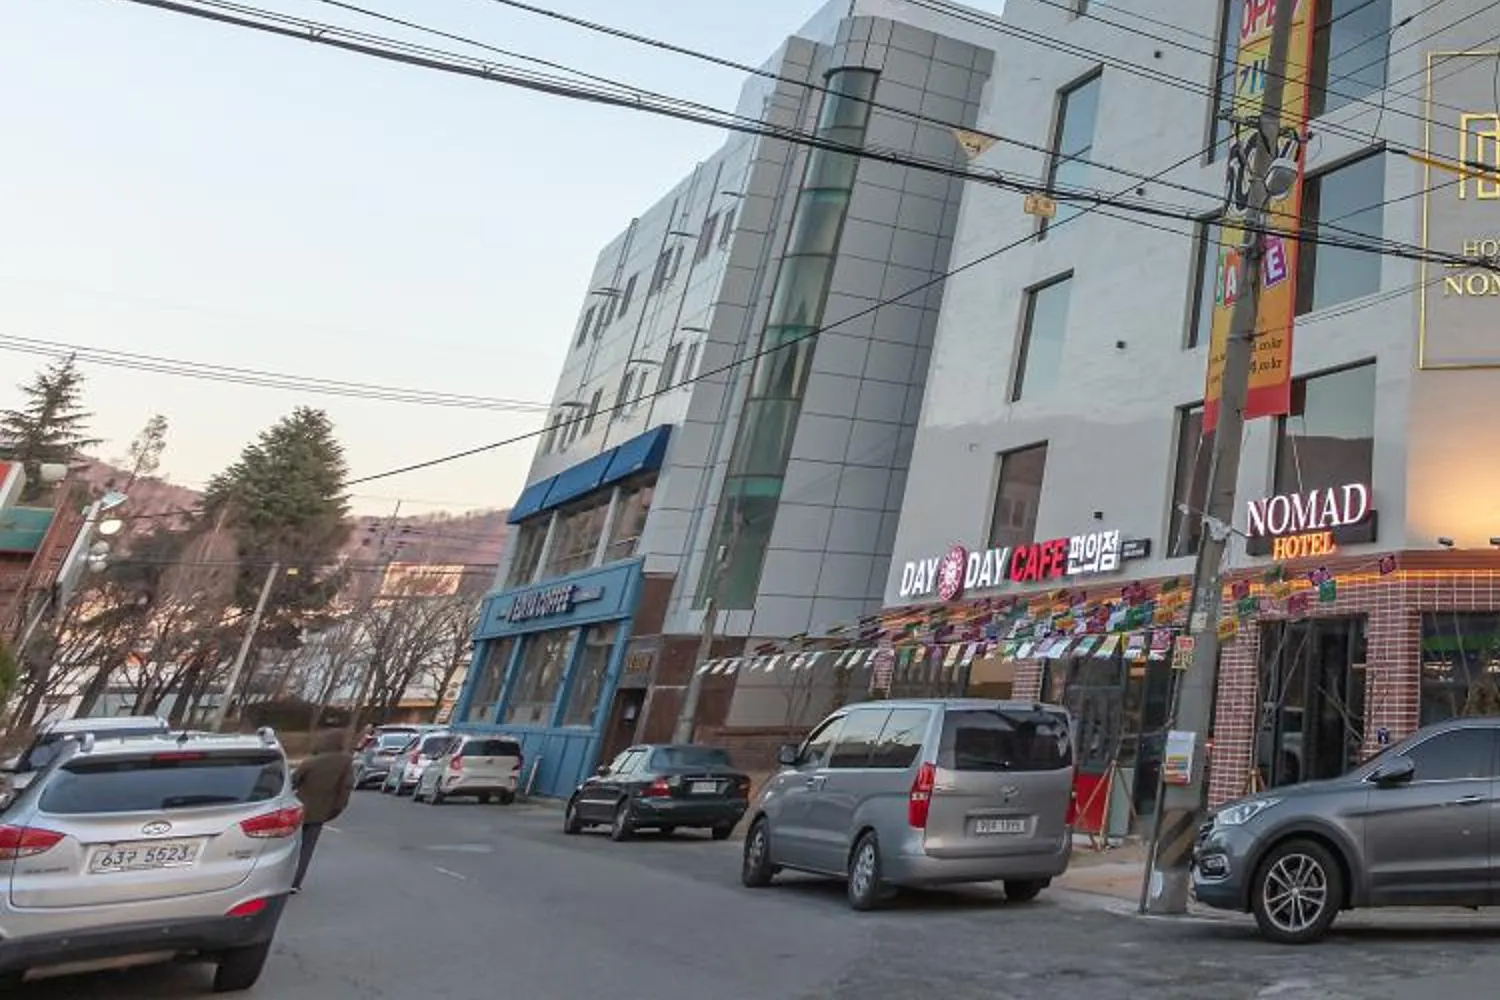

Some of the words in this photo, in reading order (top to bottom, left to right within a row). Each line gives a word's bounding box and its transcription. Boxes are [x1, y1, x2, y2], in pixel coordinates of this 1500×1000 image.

[1216, 245, 1284, 300] SAE
[1246, 483, 1367, 537] NOMAD
[900, 557, 939, 597] DAY
[964, 547, 1009, 589] DAY
[1010, 538, 1070, 584] CAFE
[1067, 529, 1119, 575] 편의점
[1273, 531, 1337, 561] HOTEL
